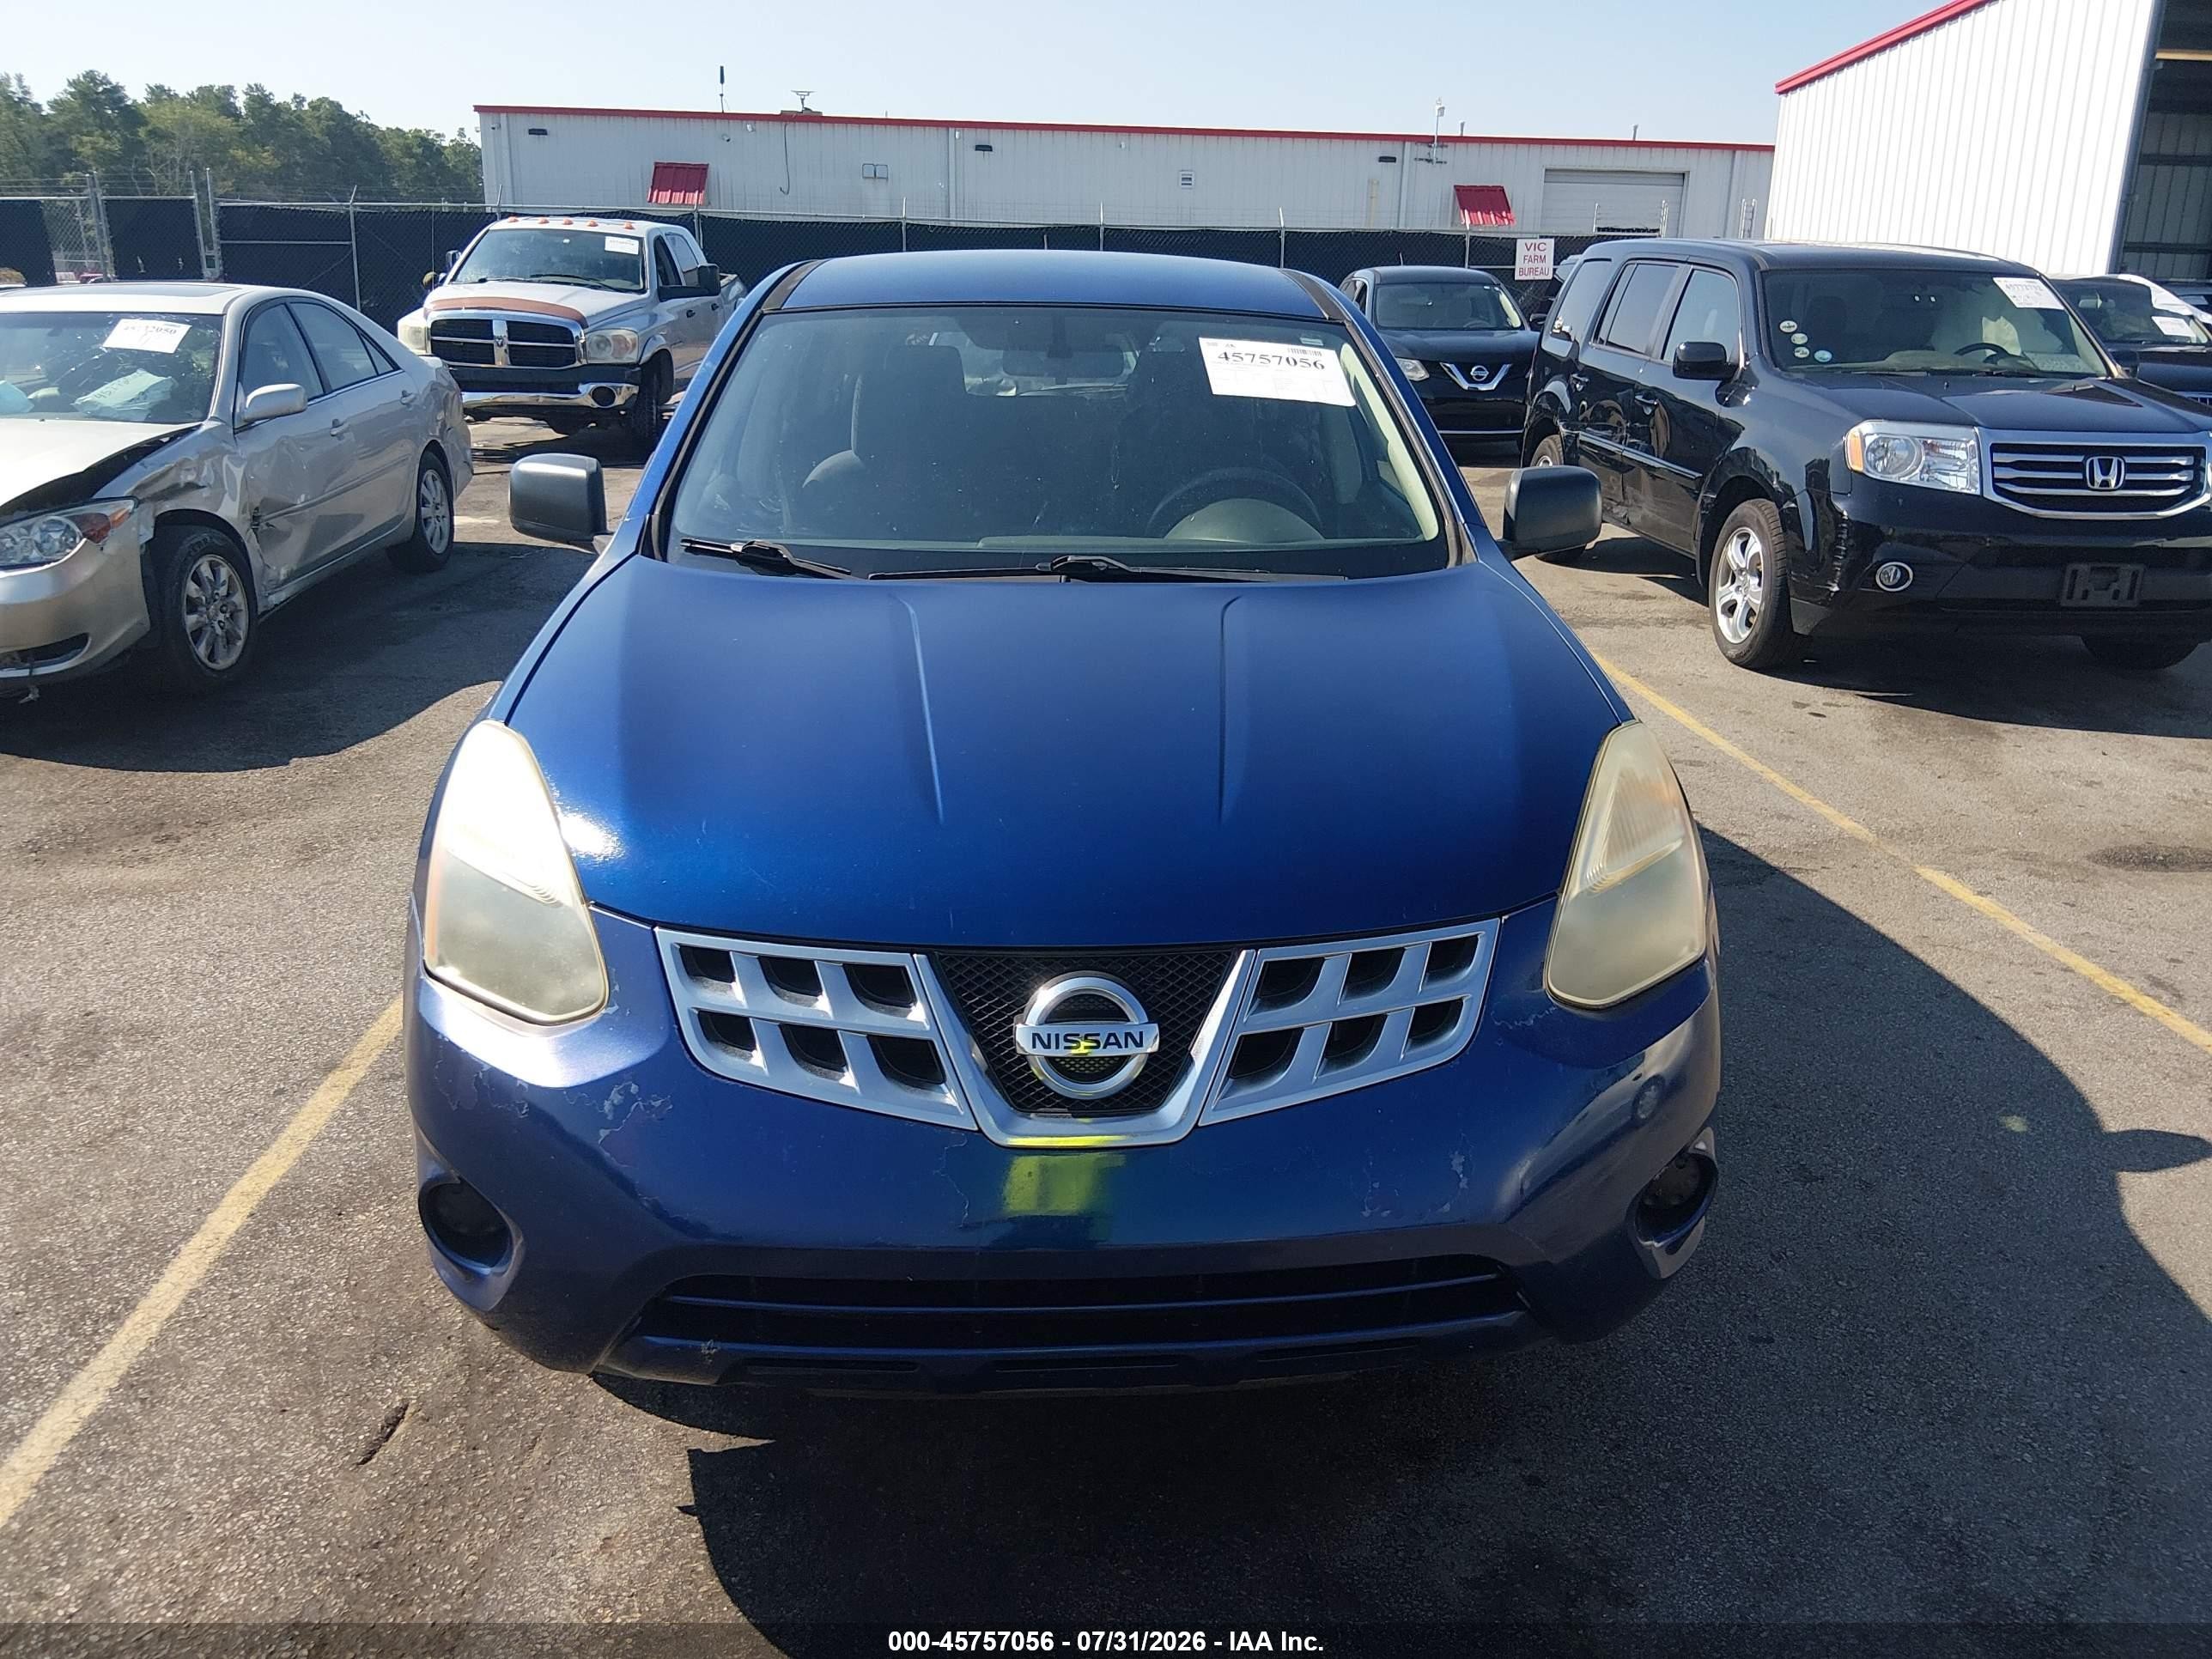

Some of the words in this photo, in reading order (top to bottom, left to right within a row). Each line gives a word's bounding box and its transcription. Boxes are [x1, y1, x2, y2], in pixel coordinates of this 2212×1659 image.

[1524, 242, 1547, 252] VIC
[1522, 255, 1547, 264] FARM
[1518, 267, 1549, 276] BUREAU
[1218, 350, 1325, 370] 45757056
[1031, 1030, 1144, 1050] NISSAN
